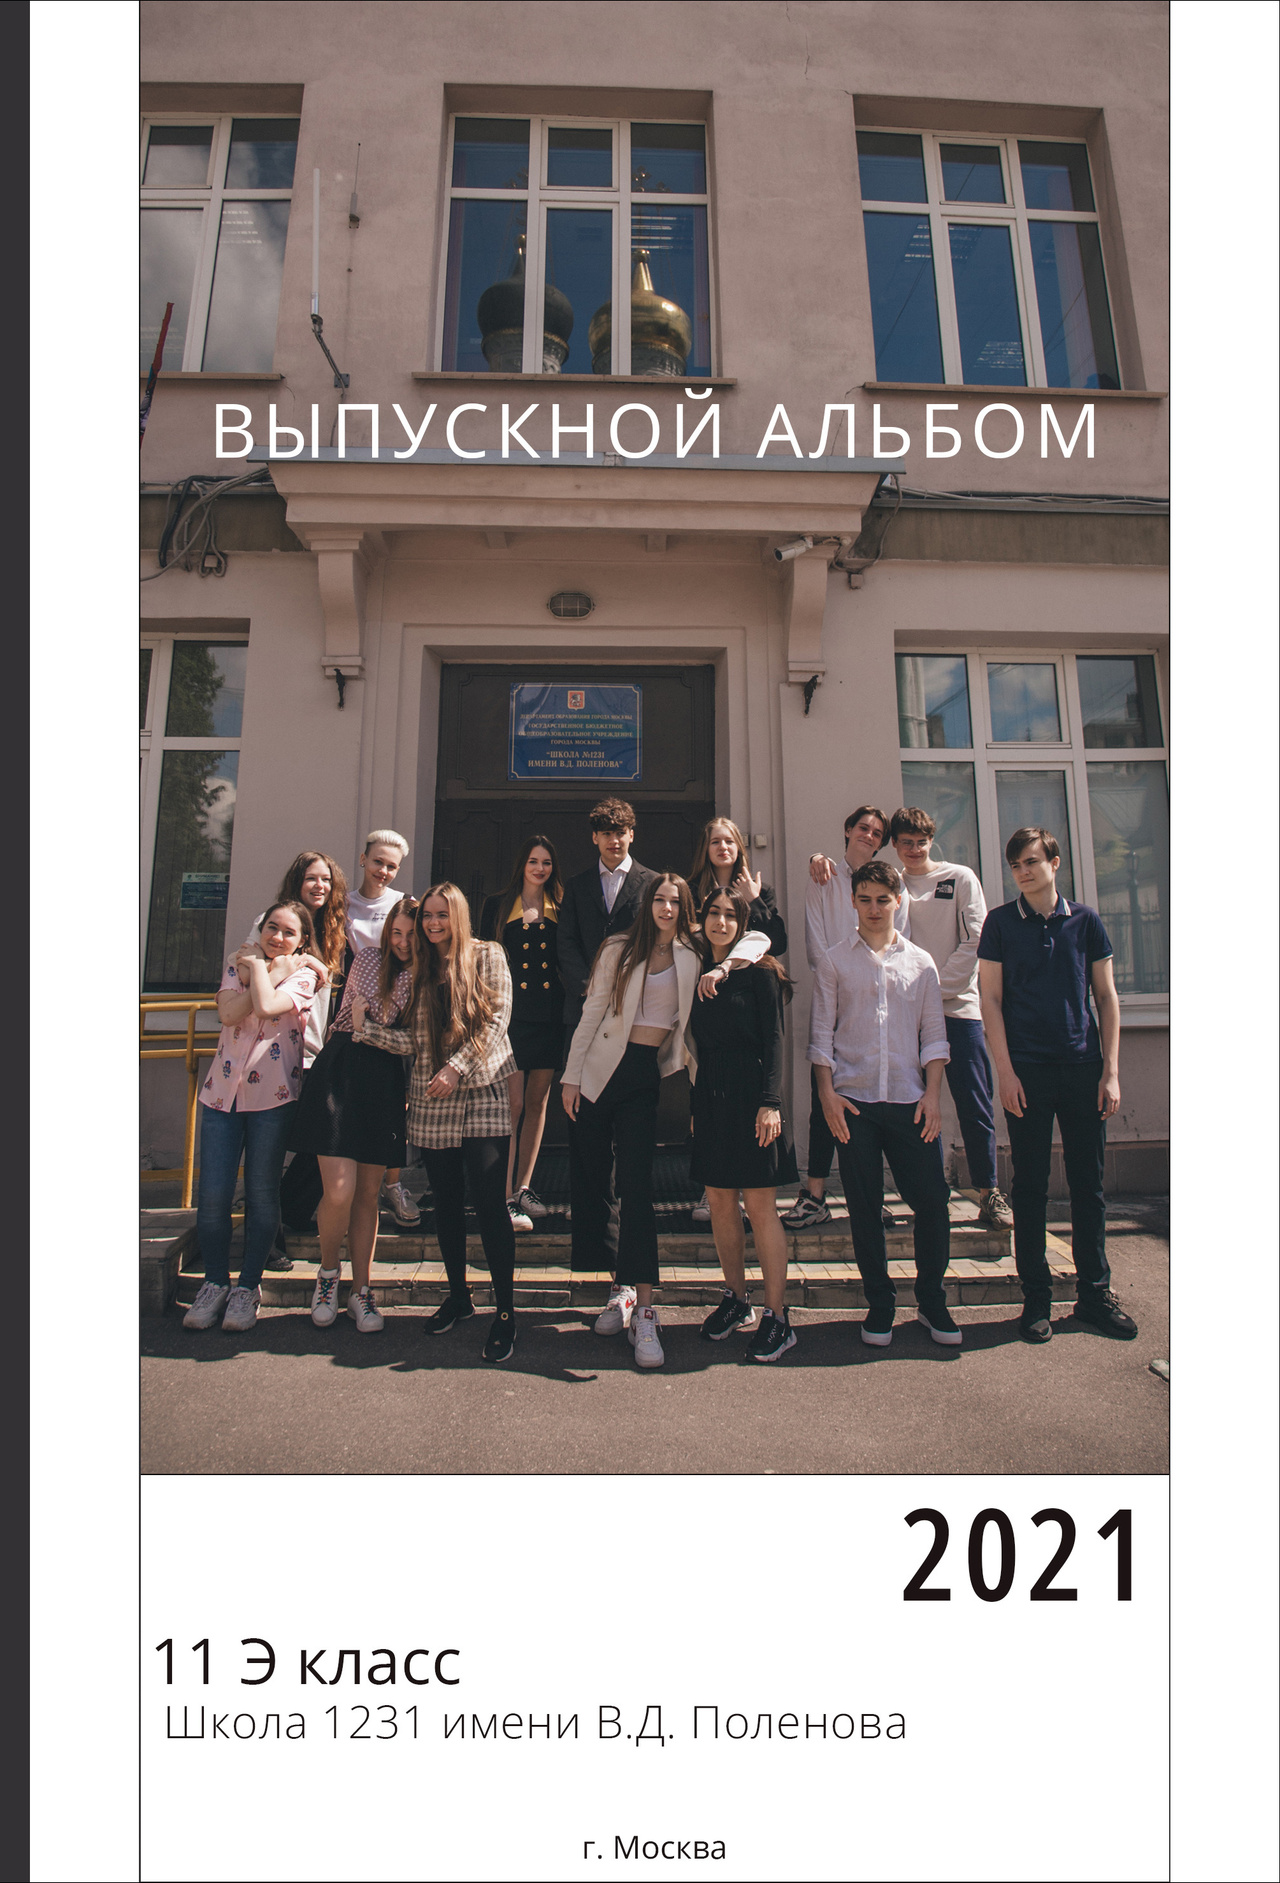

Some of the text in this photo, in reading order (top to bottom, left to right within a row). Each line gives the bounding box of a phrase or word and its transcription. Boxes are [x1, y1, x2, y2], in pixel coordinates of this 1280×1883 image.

[582, 751, 605, 759] №1231
[528, 760, 557, 768] ИМЕНИ
[559, 760, 574, 769] В.Д.
